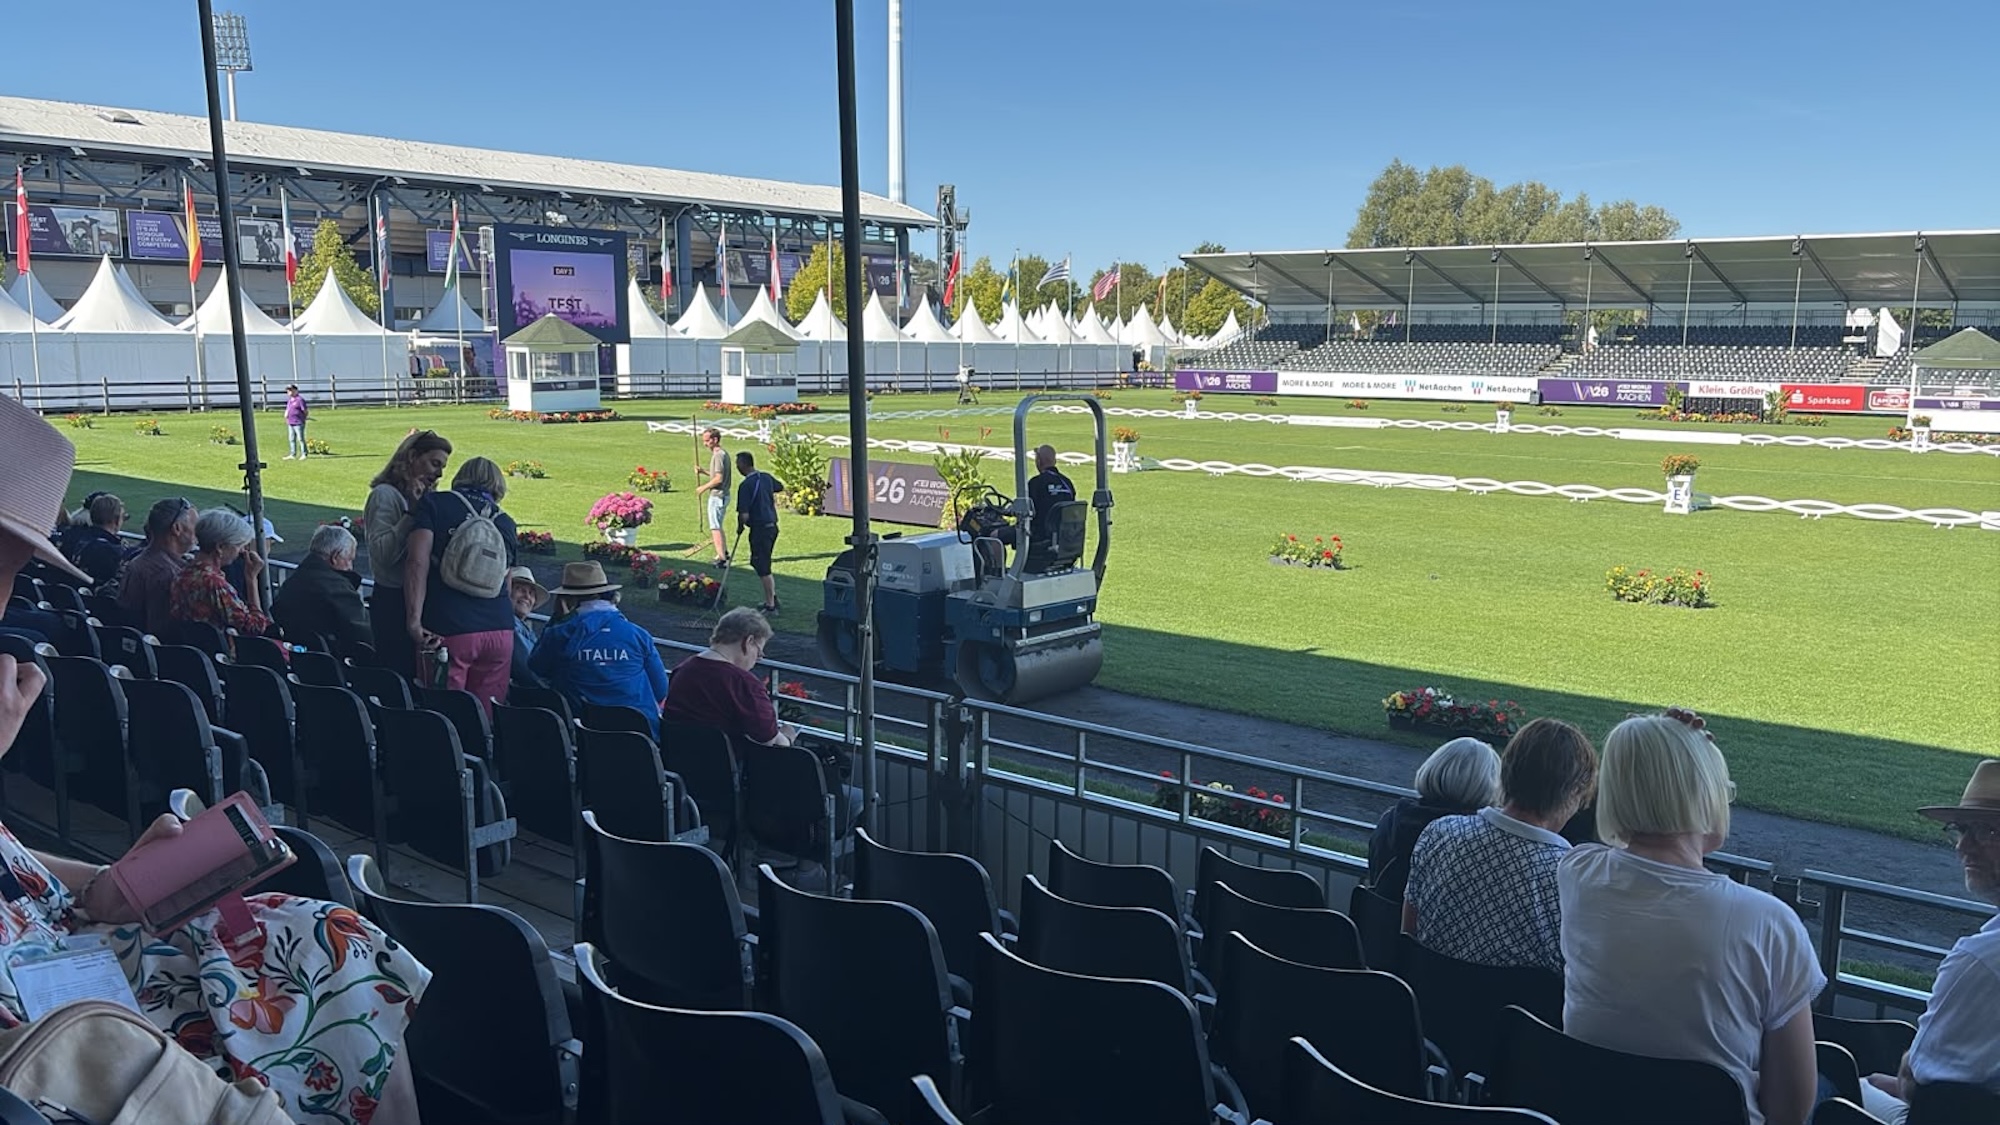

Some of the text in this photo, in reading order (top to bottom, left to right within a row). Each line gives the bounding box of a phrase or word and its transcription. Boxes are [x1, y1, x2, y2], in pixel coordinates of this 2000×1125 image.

[536, 233, 588, 246] LONGINES
[548, 298, 582, 310] TEST
[1419, 384, 1462, 392] NetAachen
[1487, 386, 1531, 394] NetAachen
[1698, 385, 1726, 394] Klein.
[1616, 393, 1652, 402] AACHEN
[1808, 396, 1850, 405] Sparkasse
[1872, 396, 1910, 406] LAMBERT
[1674, 490, 1680, 500] E
[910, 494, 946, 509] AACHE
[578, 650, 629, 660] ITALIA
